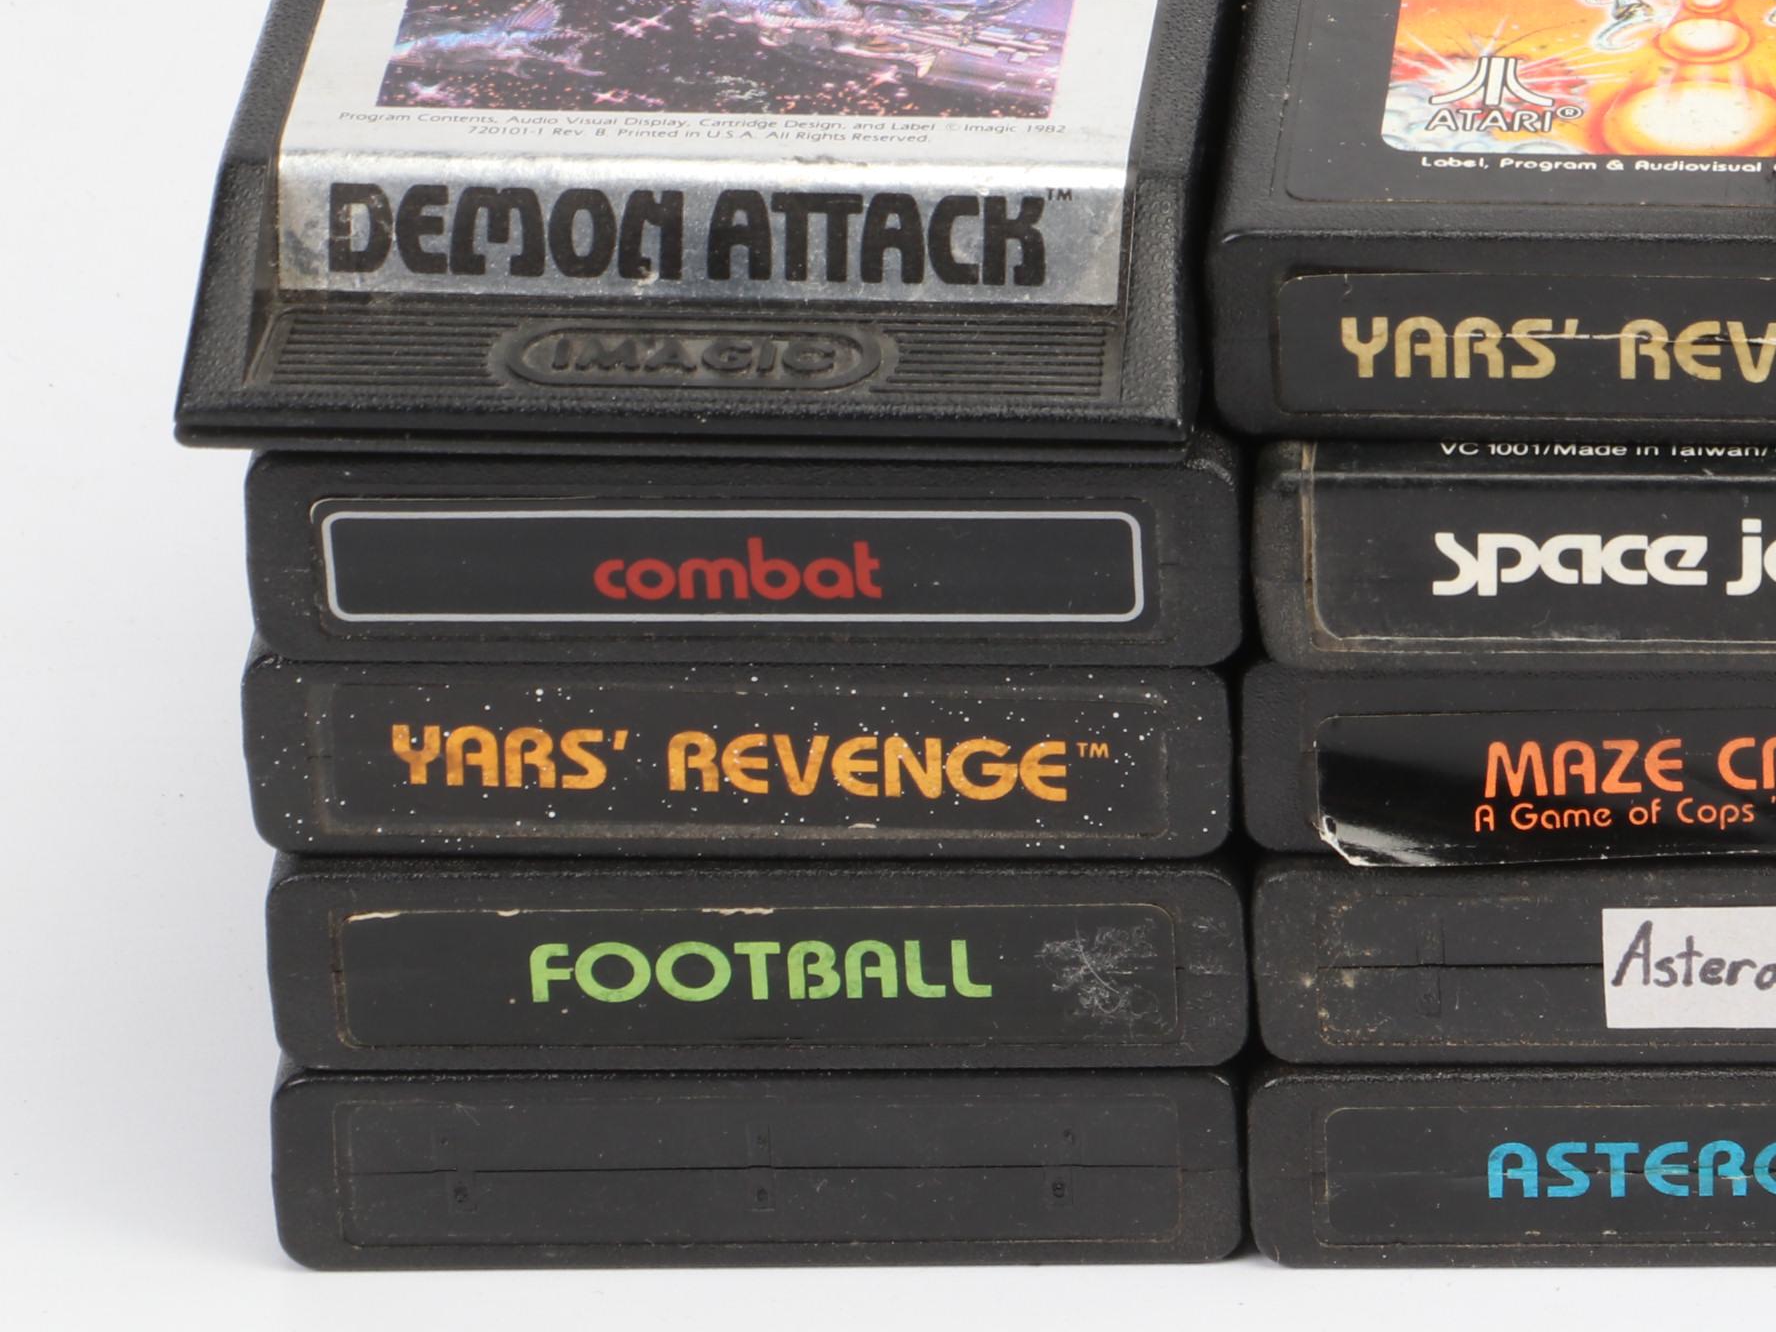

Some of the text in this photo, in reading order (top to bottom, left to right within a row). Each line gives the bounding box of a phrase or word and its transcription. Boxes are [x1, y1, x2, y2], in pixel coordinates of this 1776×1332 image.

[339, 111, 411, 124] Program
[508, 115, 559, 126] Audio
[566, 116, 618, 126] Visual
[698, 118, 778, 131] Cartridge
[853, 121, 886, 132] and
[891, 122, 936, 132] Label
[963, 123, 1017, 135] Imagic
[1026, 124, 1067, 135] 1982
[617, 128, 679, 139] Printed
[684, 130, 701, 139] in
[766, 131, 790, 141] All
[795, 131, 847, 144] Rights
[1421, 156, 1489, 170] Label,
[1500, 157, 1597, 173] Program
[1606, 159, 1624, 172] &
[1634, 159, 1762, 173] Audiovisual
[329, 182, 685, 282] DEMON
[551, 335, 838, 376] IMAGIC
[1440, 442, 1479, 456] VC
[594, 535, 883, 601] combat
[1432, 530, 1709, 598] space
[1483, 737, 1685, 799] MAZE
[1473, 804, 1495, 833] A
[1511, 802, 1613, 830] Game
[1629, 798, 1663, 826] of
[1676, 797, 1756, 831] Cops
[529, 939, 993, 1003] FOOTBALL
